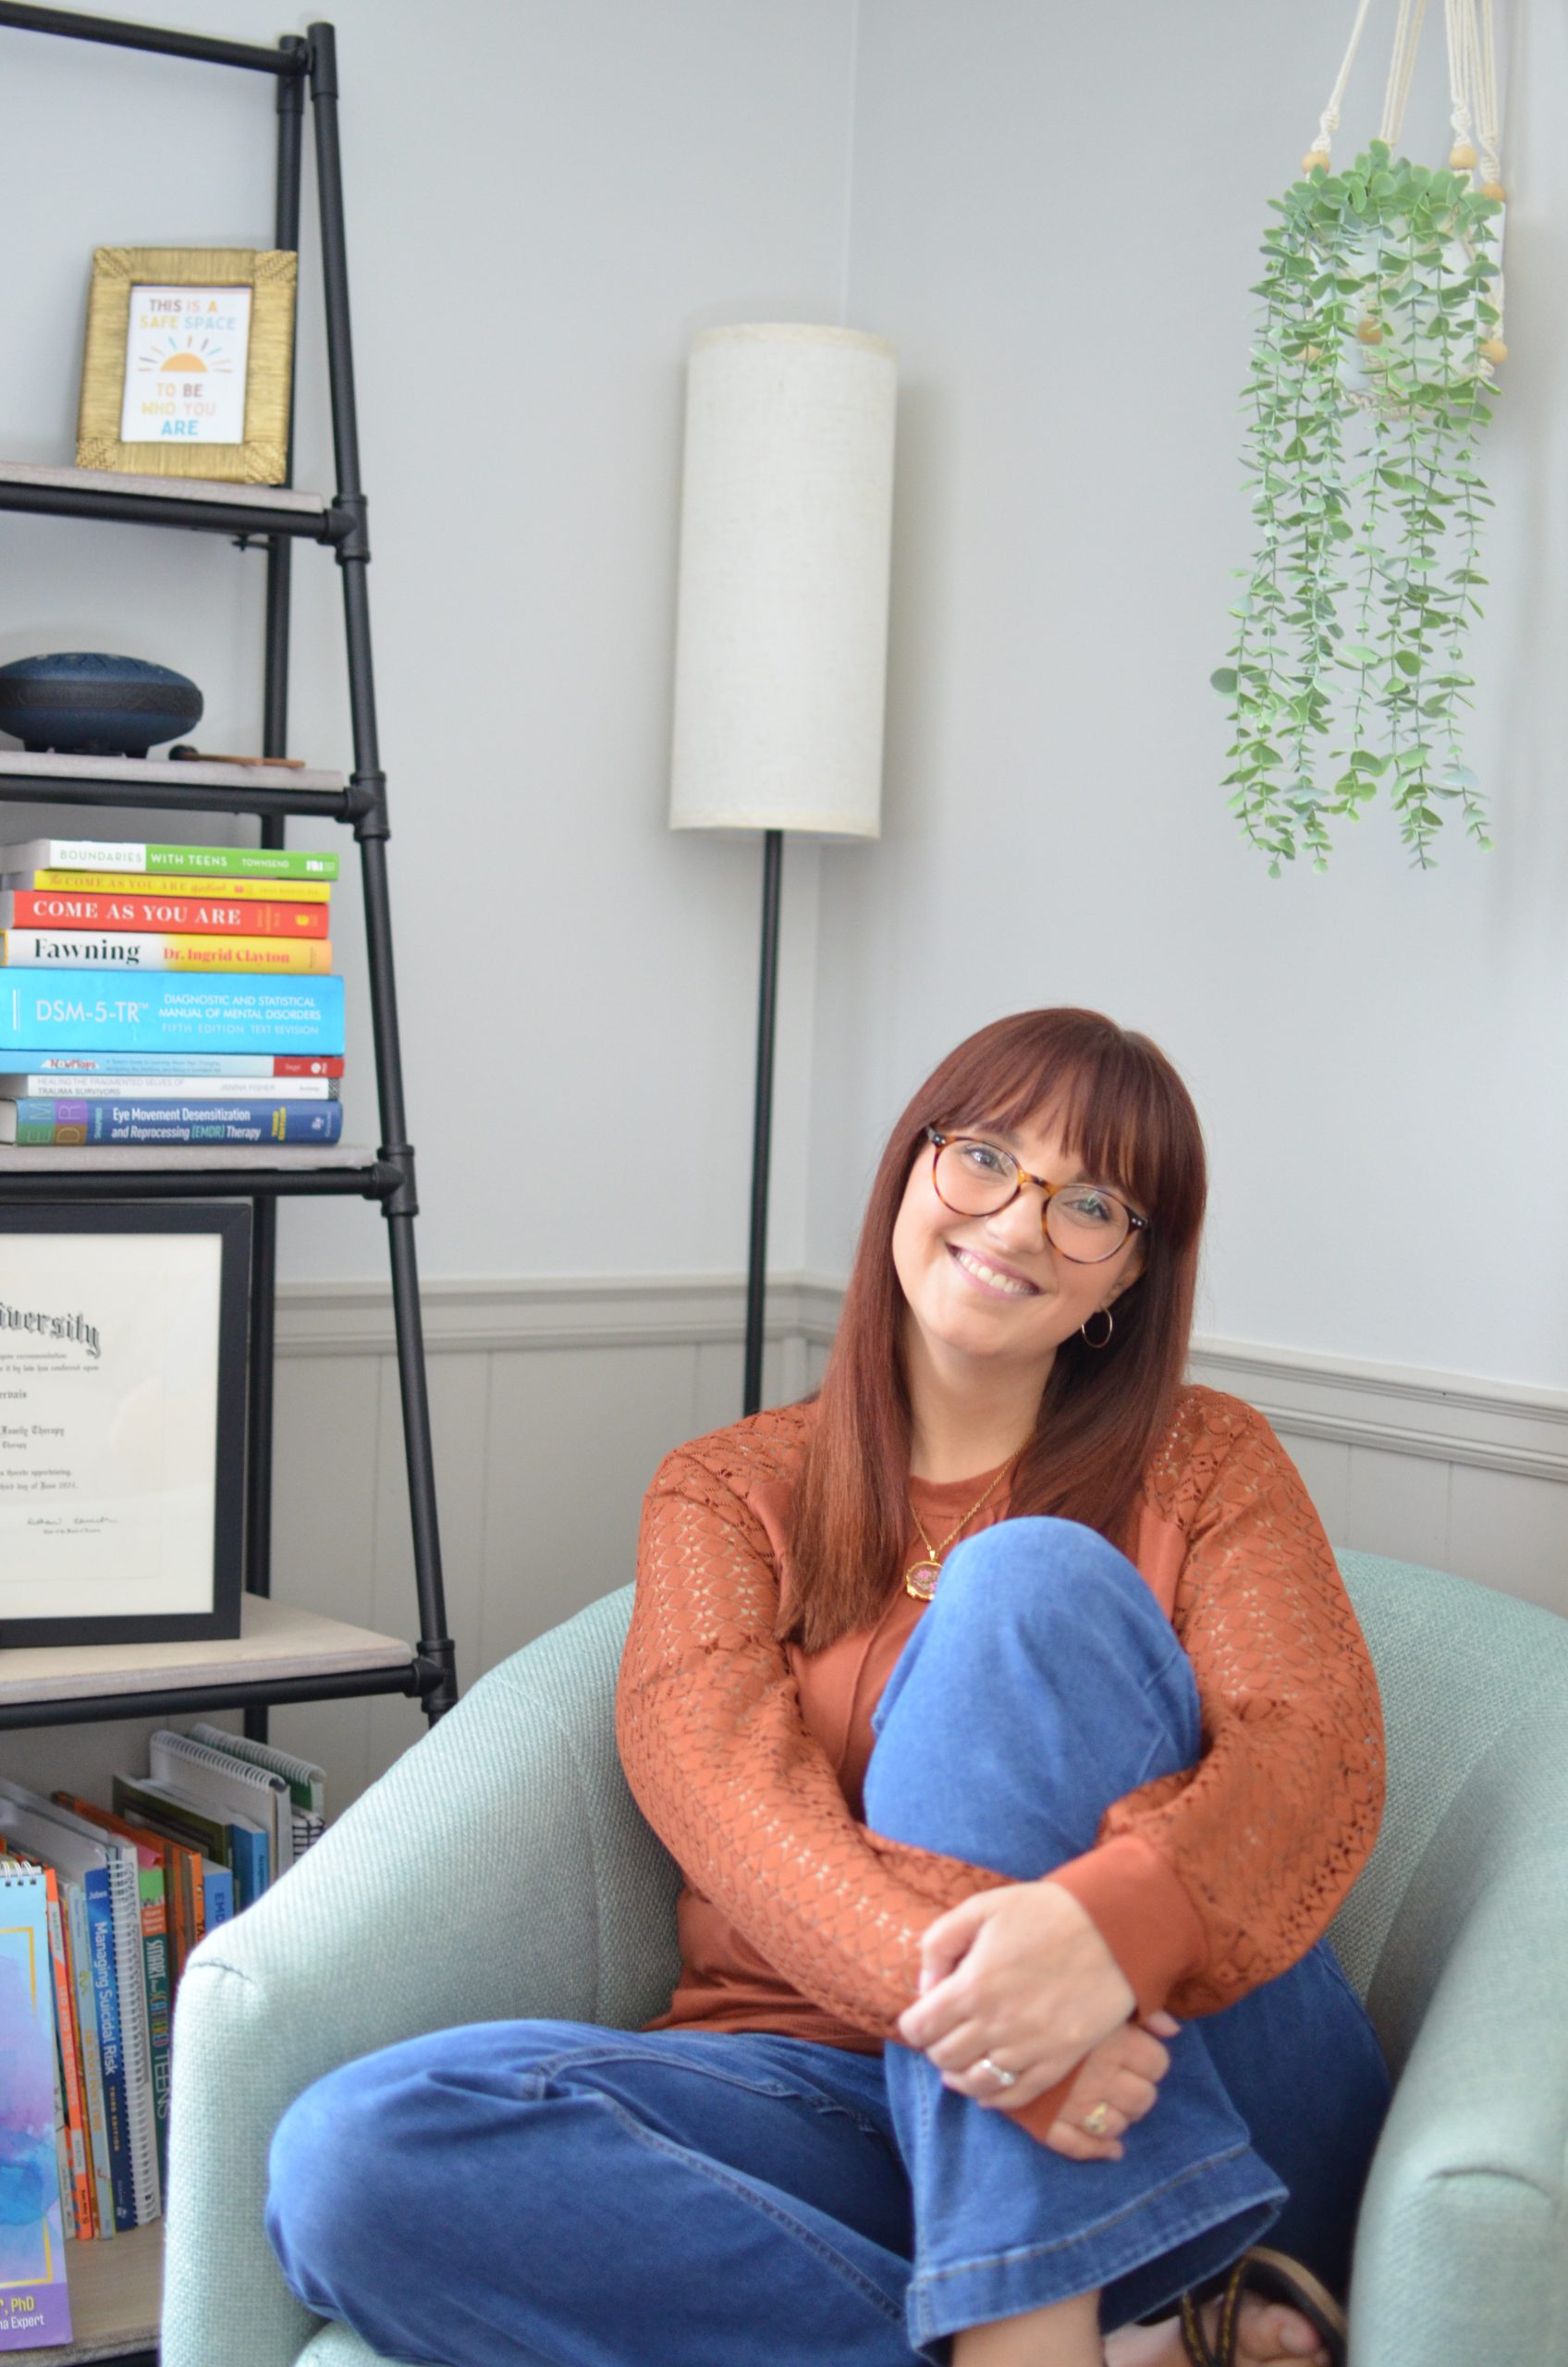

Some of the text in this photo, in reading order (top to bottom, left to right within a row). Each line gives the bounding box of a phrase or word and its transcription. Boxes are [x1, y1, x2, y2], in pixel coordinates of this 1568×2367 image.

[149, 299, 218, 313] THIS IS A
[139, 315, 236, 330] SAFE SPACE
[156, 384, 203, 398] TO BE
[141, 402, 216, 416] WHO YOU
[160, 420, 199, 435] ARE
[59, 850, 289, 869] BOUNDARIES WITH TEENS TOWNSEND
[64, 877, 104, 889] COME
[111, 877, 127, 889] AS
[33, 900, 98, 919] COME
[106, 903, 135, 921] AS
[142, 904, 189, 923] YOU
[194, 908, 242, 926] ARE
[33, 938, 141, 965] Fawning
[164, 947, 184, 961] Dr.
[188, 946, 232, 964] Ingrid
[236, 949, 290, 967] Clayton
[164, 993, 316, 1007] DIAGNOSTIC AND STATISTICAL
[158, 1007, 322, 1020] MANUAL OF MENTAL DISORDERS
[162, 1023, 319, 1035] FIFTH EDITION TEXT REVISION
[37, 1077, 72, 1085] HEALING
[74, 1077, 88, 1085] THE
[90, 1078, 143, 1086] FRAGMENTED
[38, 1087, 121, 1096] TRAUMA SURVIVORS
[113, 1108, 251, 1124] Eye Movement Desensitization
[111, 1124, 262, 1142] and Reprocessing (EMDR) Therapy
[31, 1425, 65, 1437] Therapy
[146, 1939, 166, 1980] SMART
[93, 1921, 118, 2077] Managing Suicidal Risk
[153, 2050, 171, 2119] TEENS
[111, 2115, 120, 2152] EDITION
[10, 2296, 35, 2312] PhD
[10, 2314, 45, 2330] Expert
